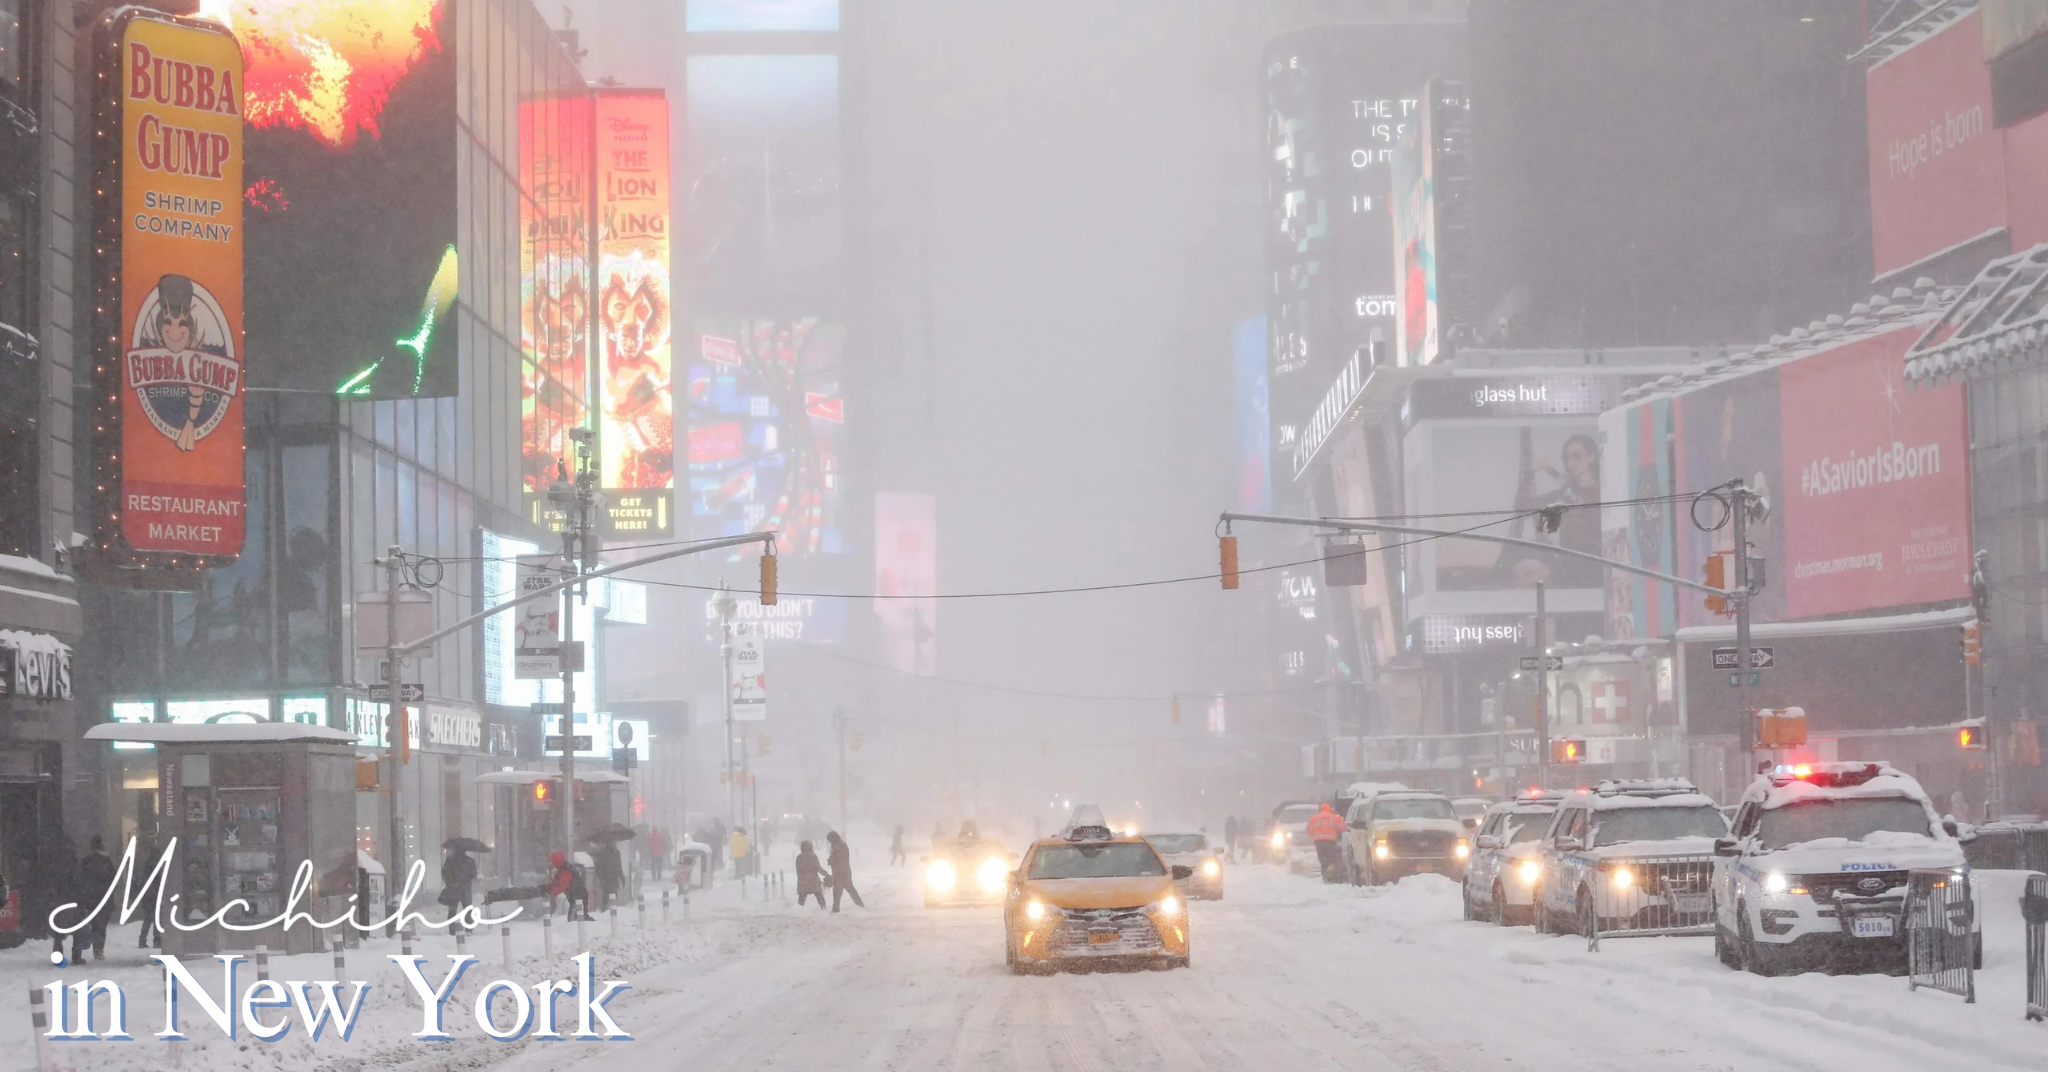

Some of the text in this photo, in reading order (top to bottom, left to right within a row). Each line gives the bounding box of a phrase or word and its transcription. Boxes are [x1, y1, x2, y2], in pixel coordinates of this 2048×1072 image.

[128, 42, 238, 116] BUBBA
[1351, 100, 1392, 118] THE
[136, 113, 231, 180] GUMP
[1888, 105, 1983, 180] Hope is born
[611, 150, 649, 168] THE
[606, 171, 658, 202] LION
[144, 191, 223, 217] SHRIMP
[134, 213, 234, 243] COMPANY
[603, 204, 666, 242] KING
[130, 352, 238, 393] BUBBA GUMP
[148, 387, 188, 399] SHRIMP
[1519, 384, 1547, 402] hut
[1801, 441, 1940, 497] #ASaviorIsBorn
[128, 494, 240, 516] RESTAURANT
[620, 498, 641, 507] GET
[609, 508, 653, 518] TICKETS
[148, 523, 222, 542] MARKET
[615, 520, 647, 530] HERE!
[526, 576, 552, 584] STAR
[762, 620, 803, 640] THIS?
[1454, 626, 1482, 644] hut
[1523, 660, 1536, 668] ONE
[1718, 654, 1736, 663] ONE
[373, 688, 391, 699] ONE
[429, 711, 481, 748] SKECHERS
[166, 763, 176, 817] Newsstand
[1840, 863, 1897, 872] POLICE
